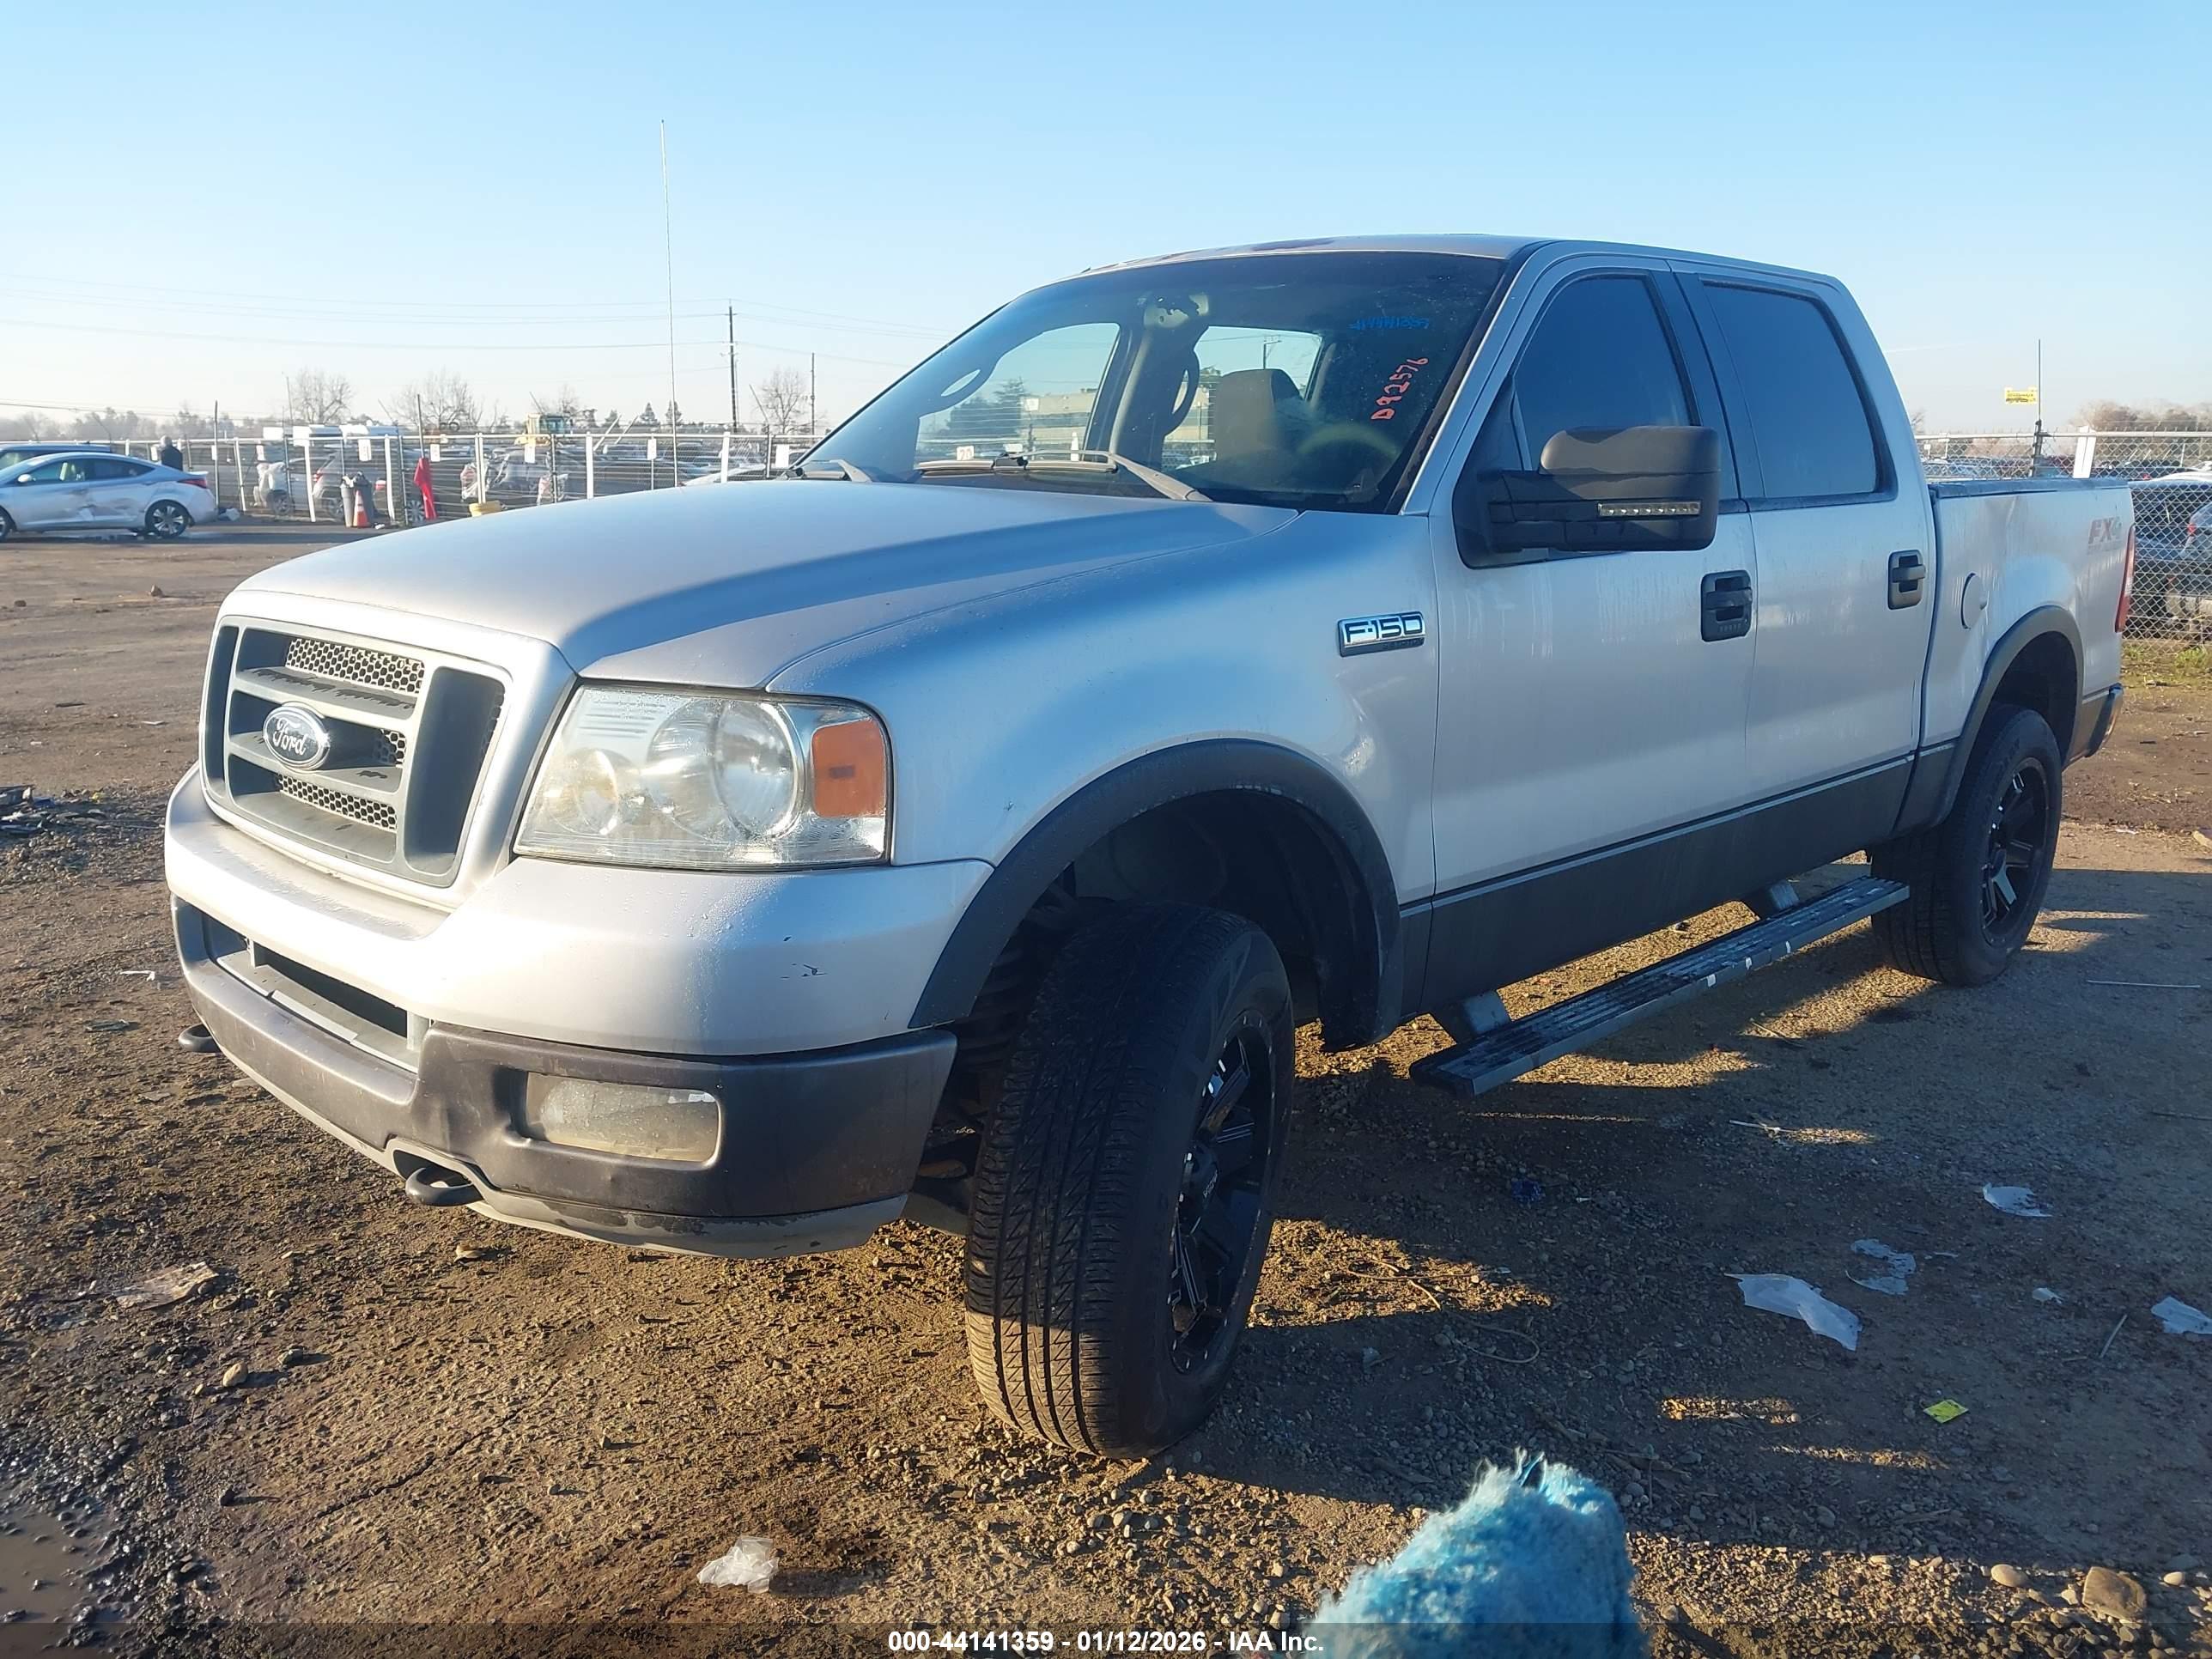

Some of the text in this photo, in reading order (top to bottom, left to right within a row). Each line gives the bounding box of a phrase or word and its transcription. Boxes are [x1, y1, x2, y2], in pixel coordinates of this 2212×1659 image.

[1370, 358, 1429, 420] D92576
[1344, 614, 1424, 643] F-150
[272, 717, 307, 756] Ford
